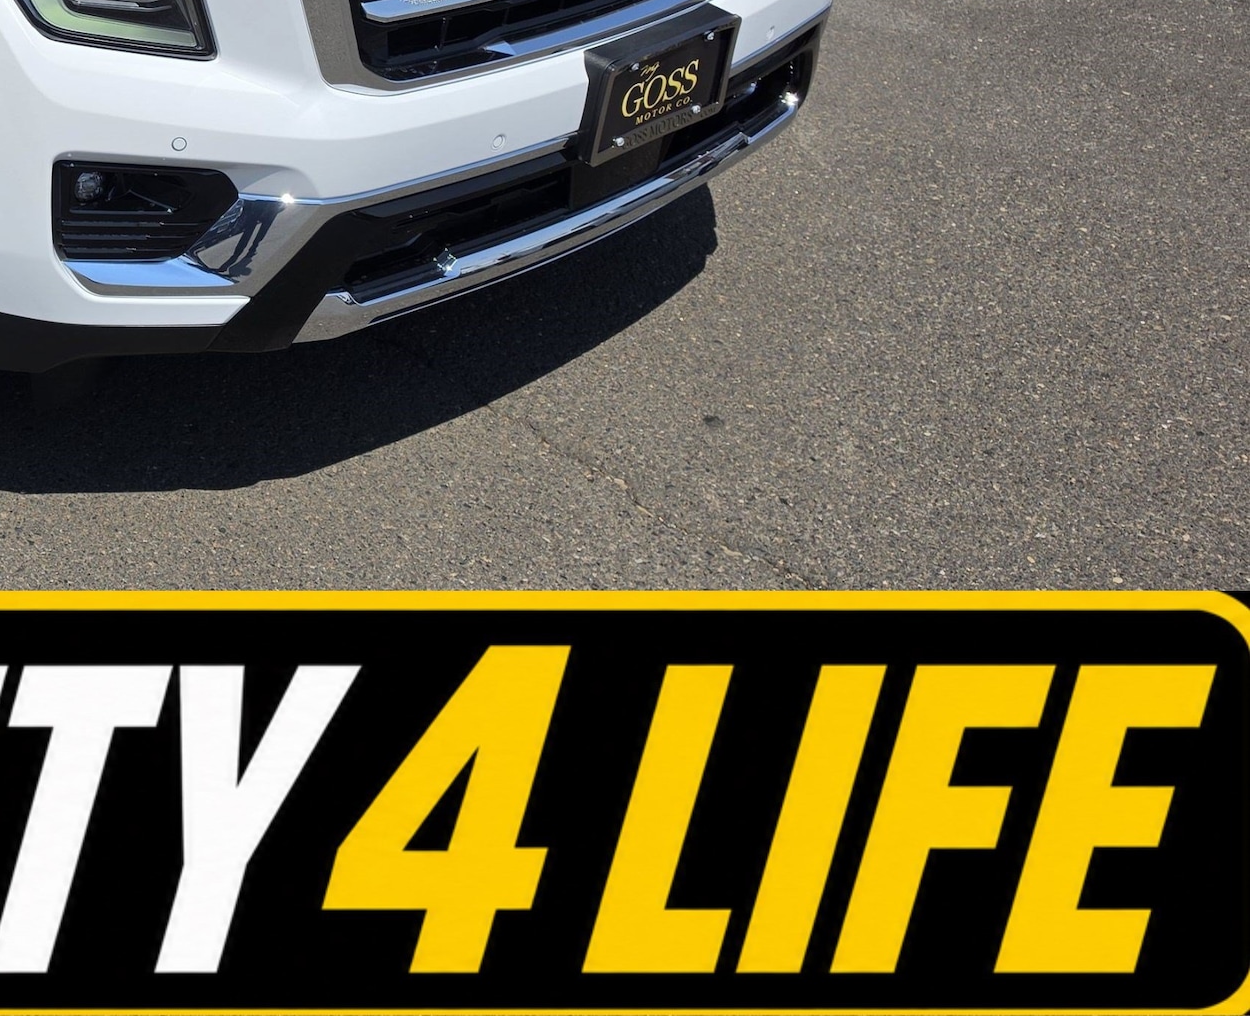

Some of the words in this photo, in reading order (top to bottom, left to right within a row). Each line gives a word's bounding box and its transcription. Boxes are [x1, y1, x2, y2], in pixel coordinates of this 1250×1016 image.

[621, 59, 699, 117] GOSS
[635, 103, 672, 125] MOTOR
[676, 96, 693, 108] CO.
